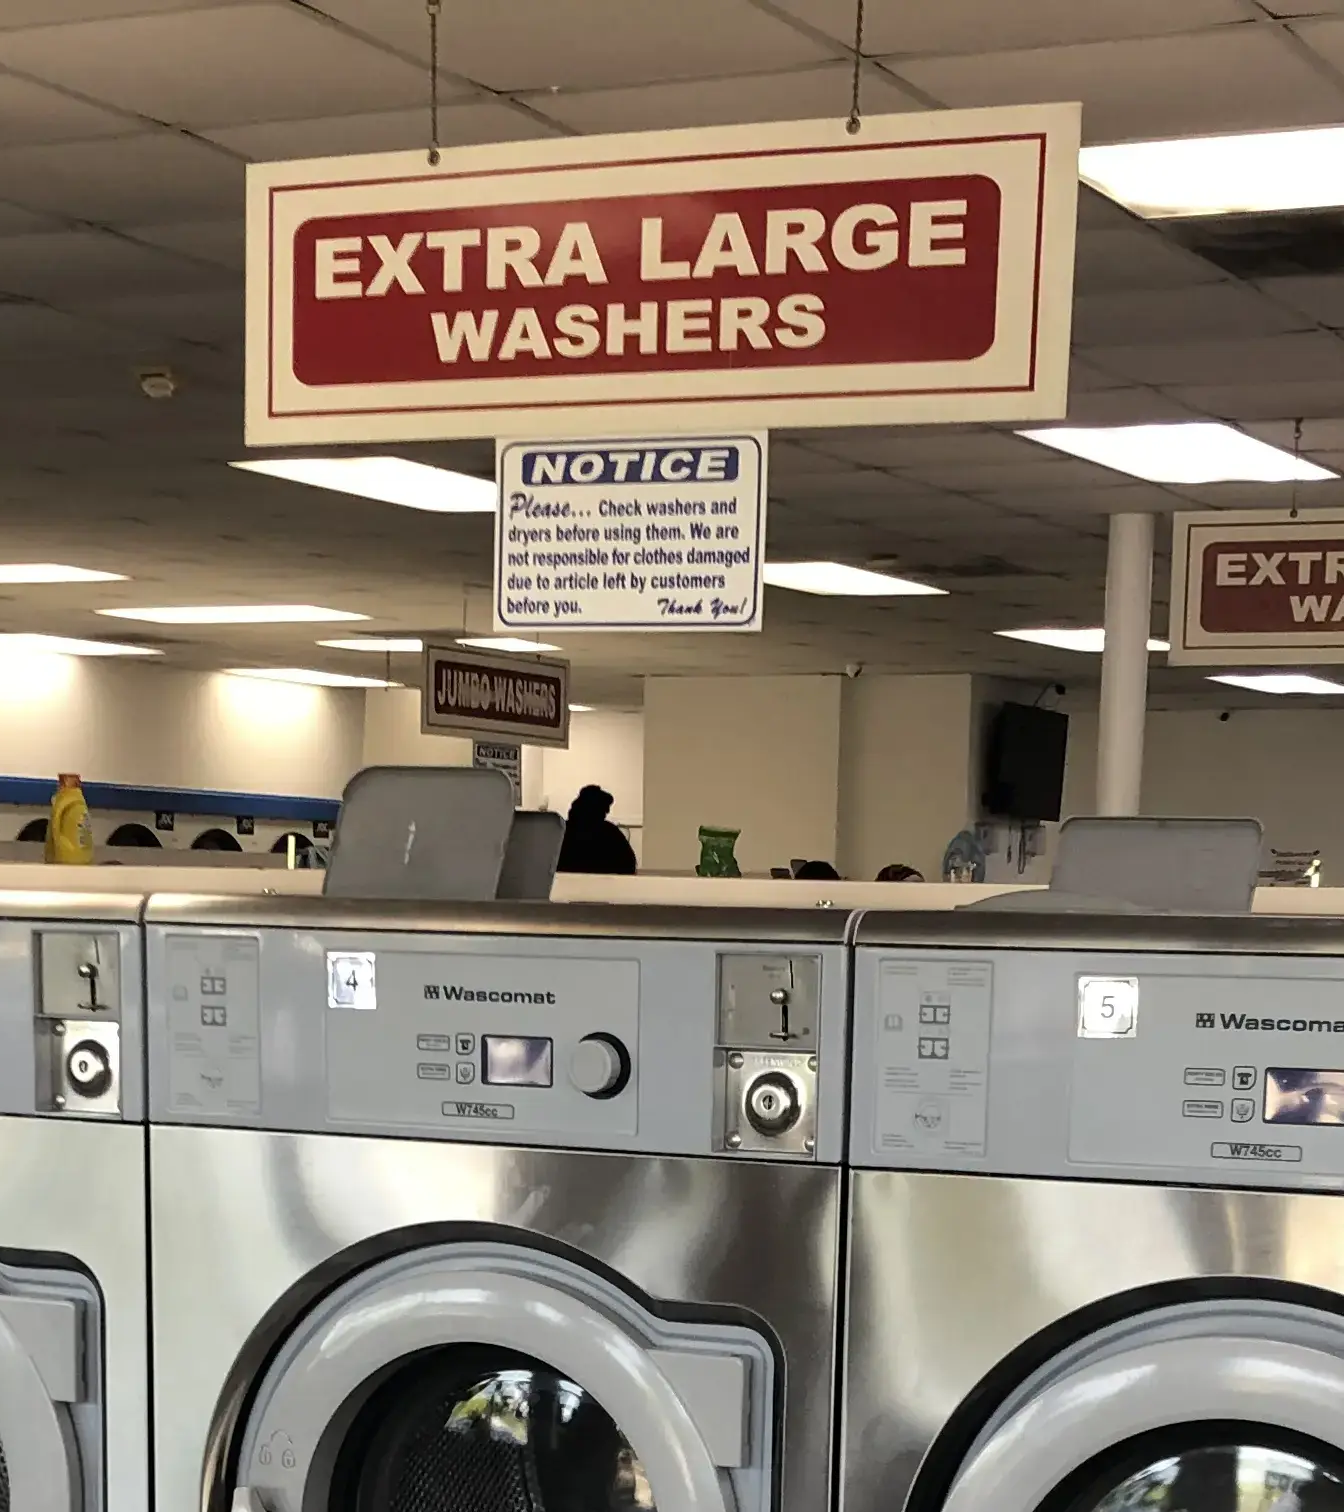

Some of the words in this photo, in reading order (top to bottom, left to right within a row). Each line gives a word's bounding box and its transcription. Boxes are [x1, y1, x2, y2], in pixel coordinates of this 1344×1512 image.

[315, 221, 609, 300] EXTRA
[640, 199, 967, 281] LARGE
[430, 293, 826, 363] WASHERS
[531, 449, 730, 485] NOTICE
[508, 491, 592, 520] Please...
[598, 499, 642, 517] Check
[647, 498, 706, 517] washers
[710, 497, 737, 515] and
[508, 525, 552, 547] dryers
[556, 524, 600, 542] before
[604, 524, 642, 545] using
[646, 523, 686, 541] them.
[689, 522, 712, 540] We
[715, 525, 739, 539] are
[508, 550, 529, 567] not
[533, 549, 609, 571] responsible
[611, 548, 631, 565] for
[633, 548, 683, 565] clothes
[686, 546, 751, 568] damaged
[507, 574, 533, 590] due
[536, 575, 550, 590] to
[554, 572, 599, 590] article
[602, 572, 626, 590] left
[630, 573, 647, 594] by
[650, 573, 726, 590] customers
[506, 597, 550, 614] before
[554, 599, 583, 618] you.
[656, 598, 703, 616] Thank
[709, 597, 748, 619] You!
[437, 668, 491, 710] JUMBO
[494, 675, 556, 720] WASHERS
[345, 969, 359, 992] 4
[443, 985, 556, 1005] Wascomat
[1100, 995, 1116, 1019] 5
[1229, 1144, 1282, 1159] W745cc
